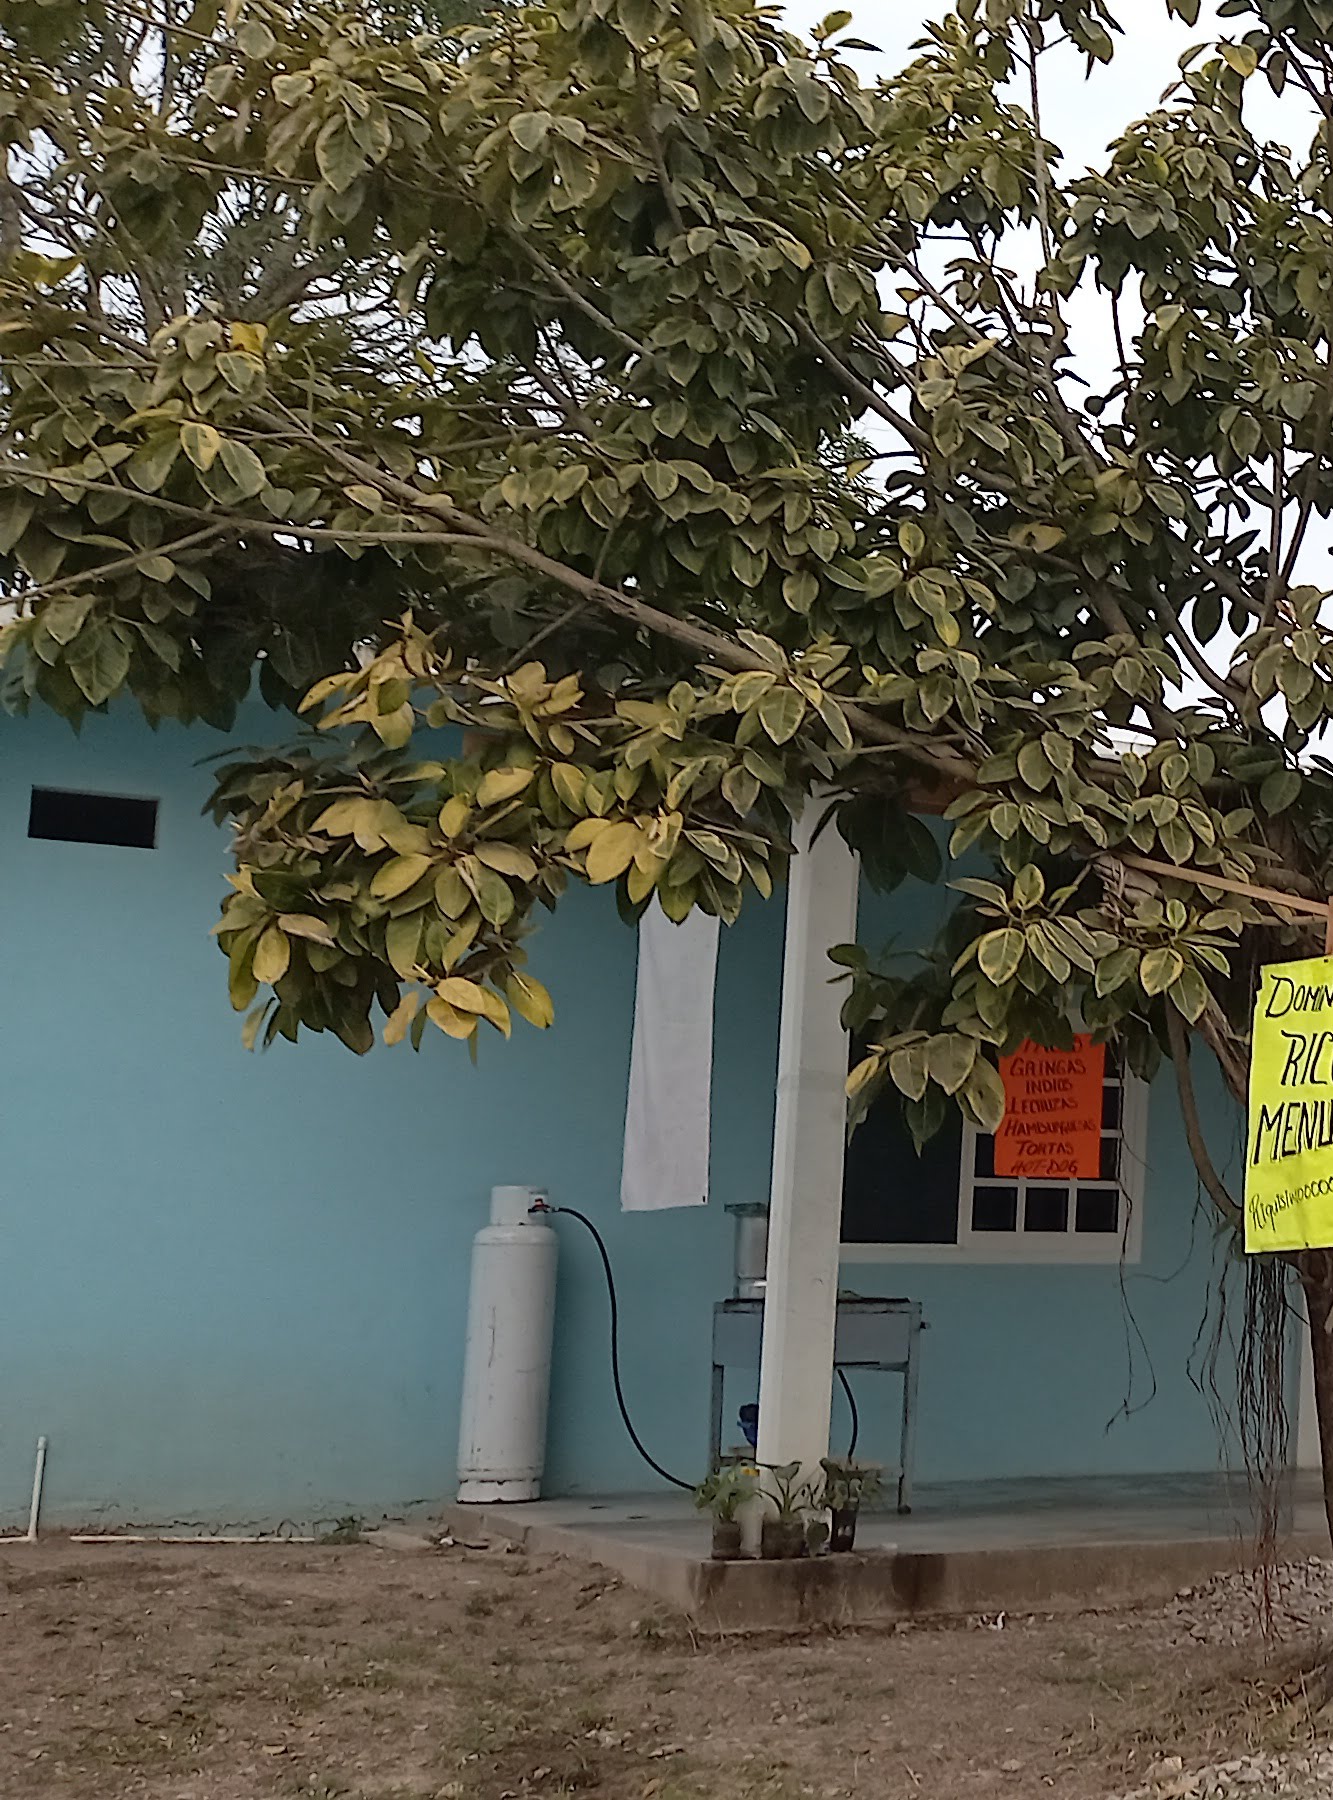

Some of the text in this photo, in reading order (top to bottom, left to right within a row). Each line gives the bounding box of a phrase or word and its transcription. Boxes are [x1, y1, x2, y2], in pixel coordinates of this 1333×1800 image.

[1009, 1057, 1087, 1077] GRINGAS
[1025, 1078, 1073, 1095] INDIOS
[1014, 1139, 1074, 1157] TORTAS
